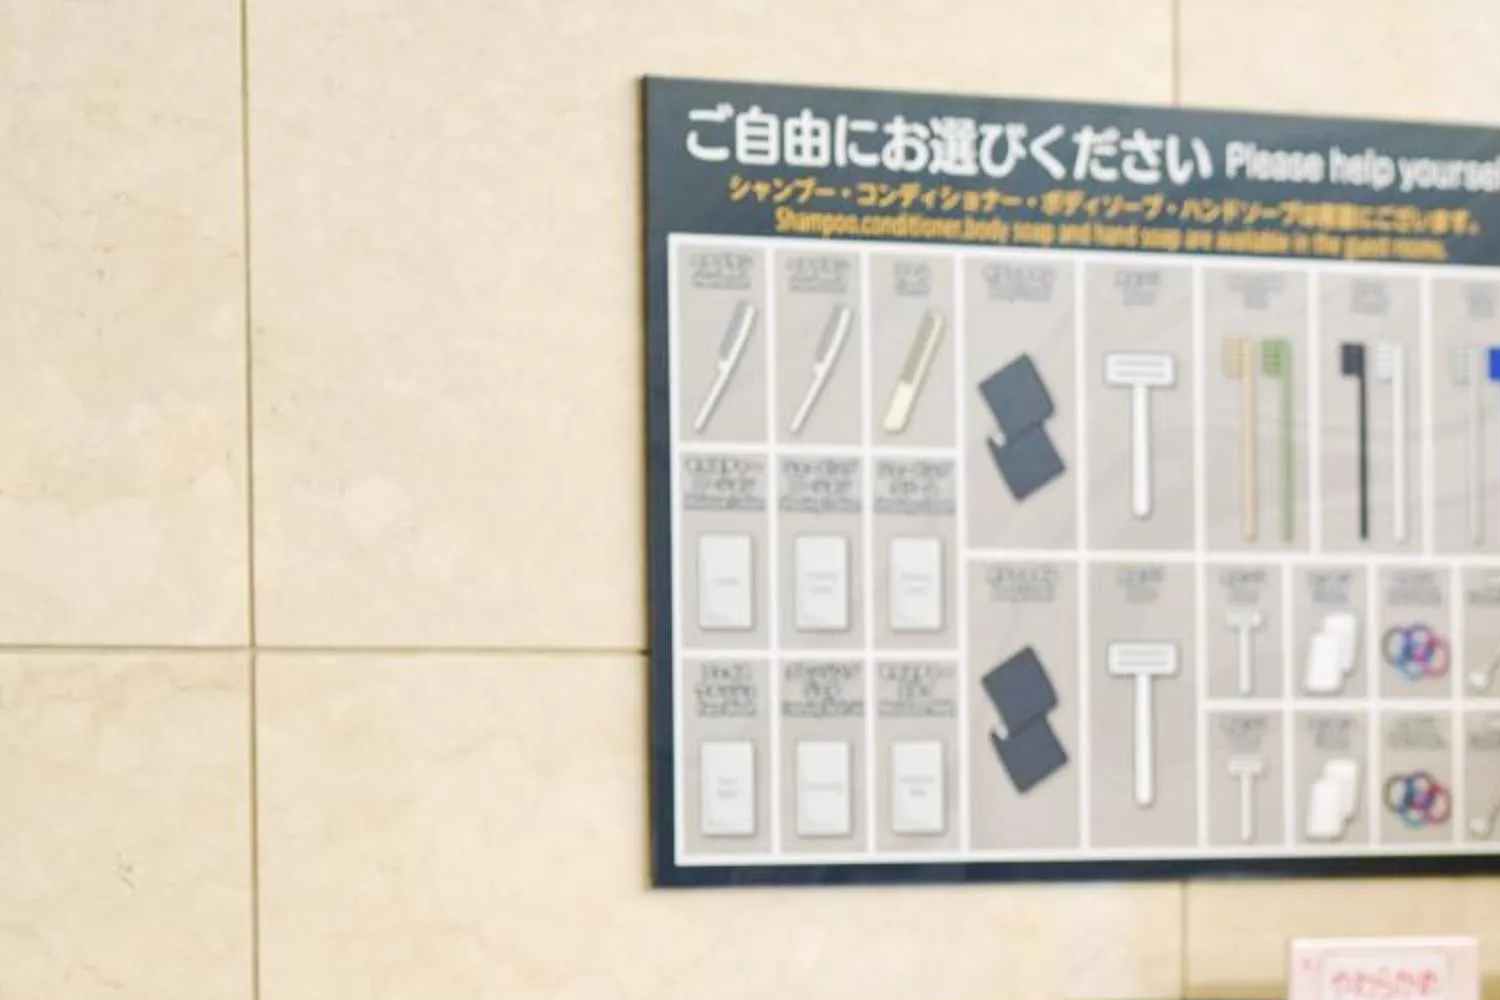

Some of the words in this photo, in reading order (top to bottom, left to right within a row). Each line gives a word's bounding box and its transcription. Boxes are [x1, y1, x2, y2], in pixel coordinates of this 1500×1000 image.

[686, 103, 1213, 186] ご自由にお選びください
[1225, 141, 1325, 184] Please
[1328, 145, 1396, 192] help
